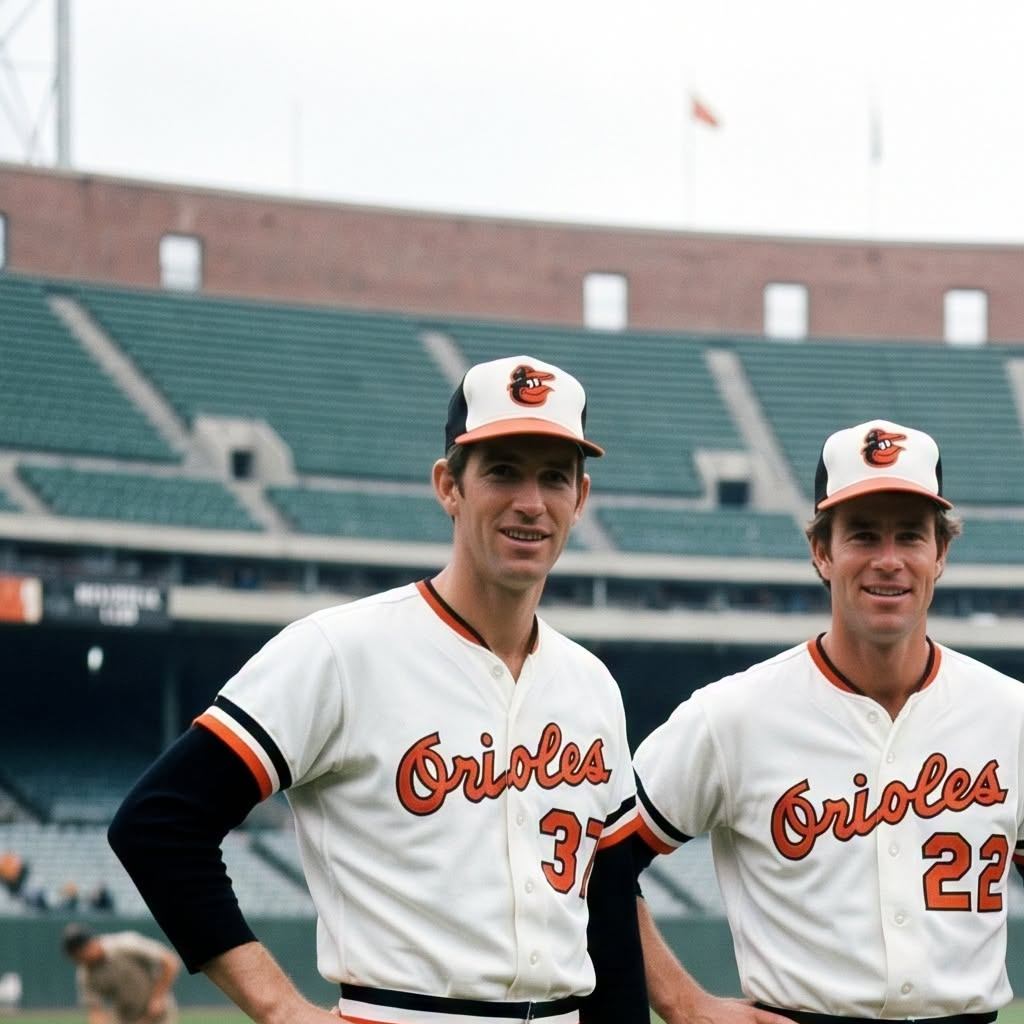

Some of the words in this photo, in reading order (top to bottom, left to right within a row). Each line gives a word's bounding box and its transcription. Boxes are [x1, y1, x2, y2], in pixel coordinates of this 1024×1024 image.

[395, 722, 613, 816] Orioles
[771, 752, 1009, 861] Orioles
[921, 831, 1009, 913] 22
